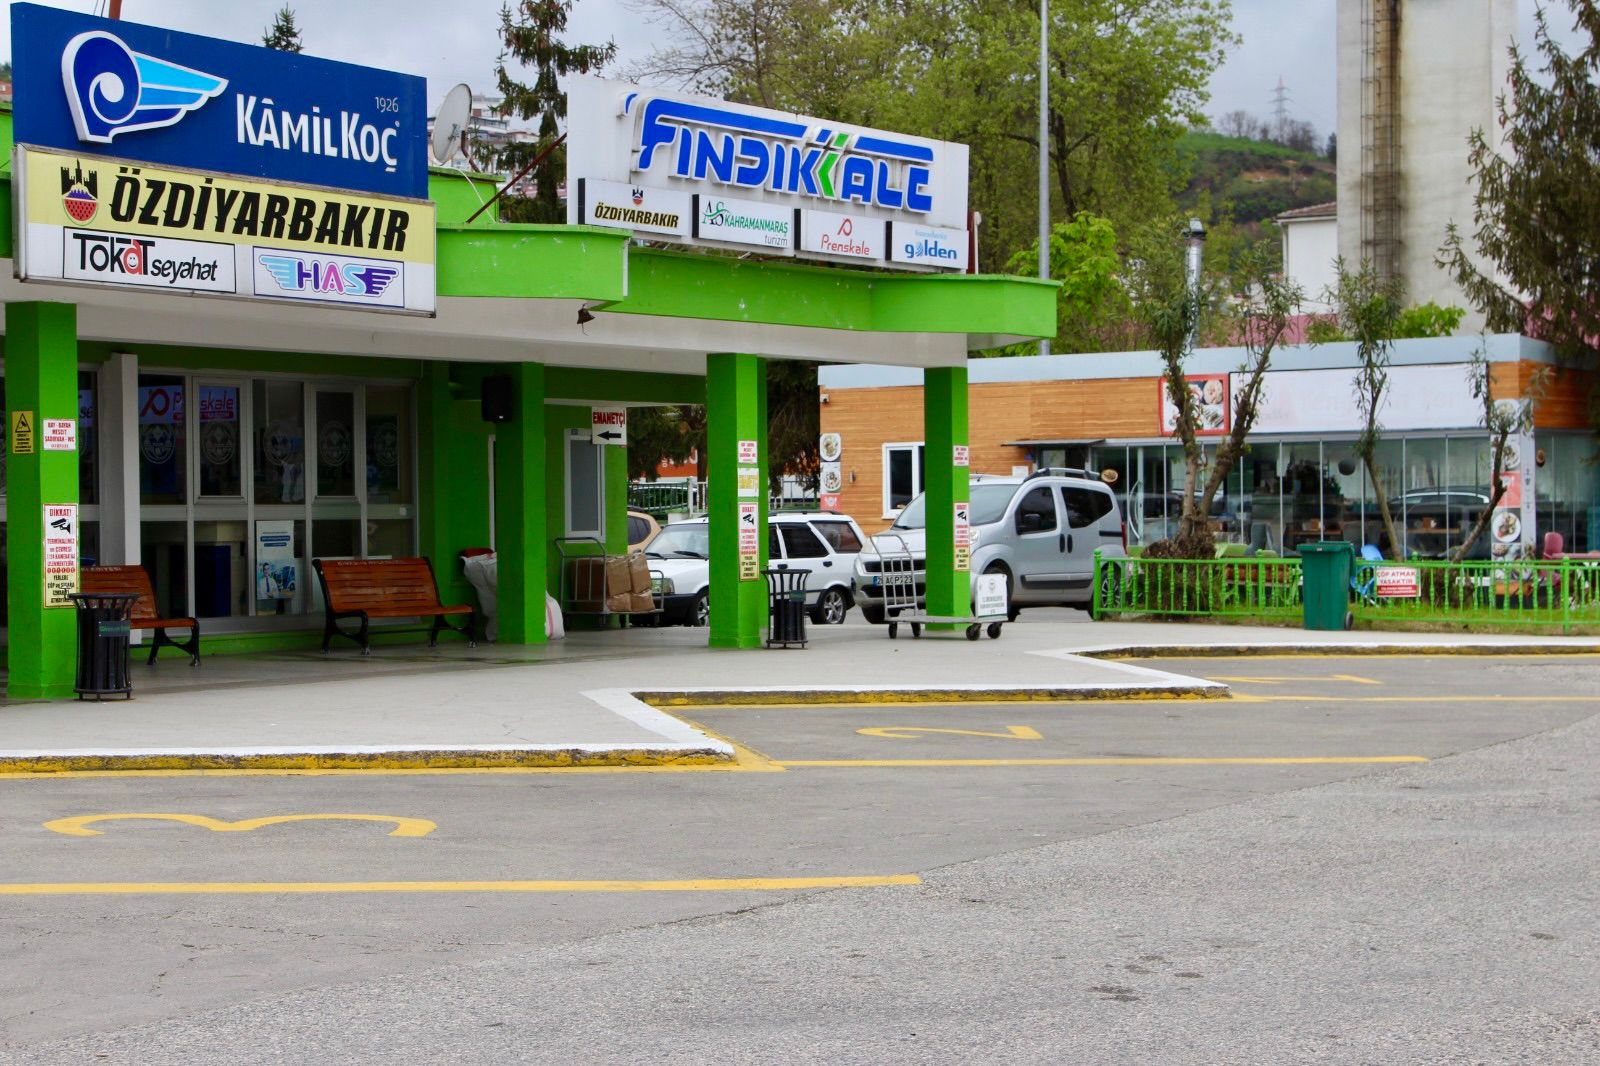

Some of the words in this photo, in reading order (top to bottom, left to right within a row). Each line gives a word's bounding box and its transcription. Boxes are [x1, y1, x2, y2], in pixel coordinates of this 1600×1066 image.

[374, 96, 399, 113] 1926
[109, 166, 411, 253] ÖZDİYARBAKIR
[595, 202, 679, 229] ÖZDİYARBAKIR
[725, 213, 788, 236] KAHRAMANMARAŞ
[764, 233, 788, 246] turizm
[821, 233, 870, 256] Prenskale
[150, 256, 218, 285] seyahat
[592, 410, 626, 428] EMANETÇİ
[41, 812, 438, 837] 3
